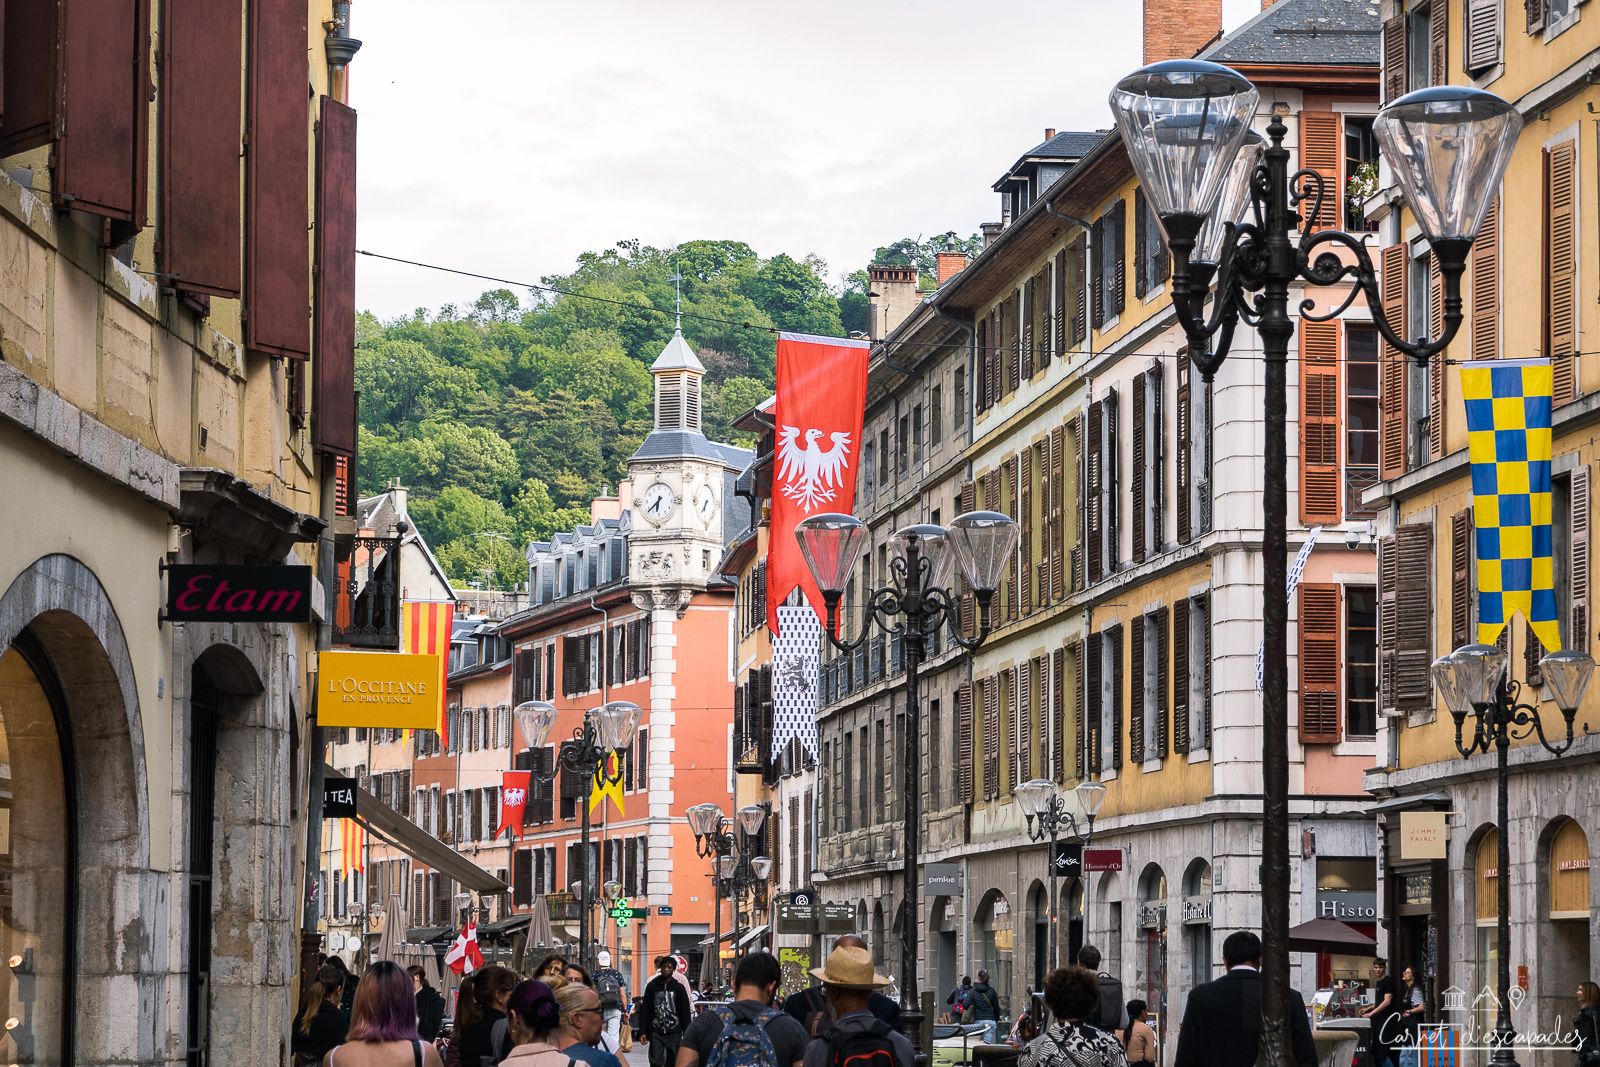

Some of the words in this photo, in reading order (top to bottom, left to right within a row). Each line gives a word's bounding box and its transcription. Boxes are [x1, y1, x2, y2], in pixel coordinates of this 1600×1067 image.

[175, 575, 303, 612] Etam
[328, 677, 426, 695] L'OCCITANE
[342, 695, 355, 703] EN
[359, 695, 412, 704] PROVENCE
[331, 788, 353, 805] TEA
[928, 876, 956, 884] pimkie
[1320, 900, 1375, 918] Histo
